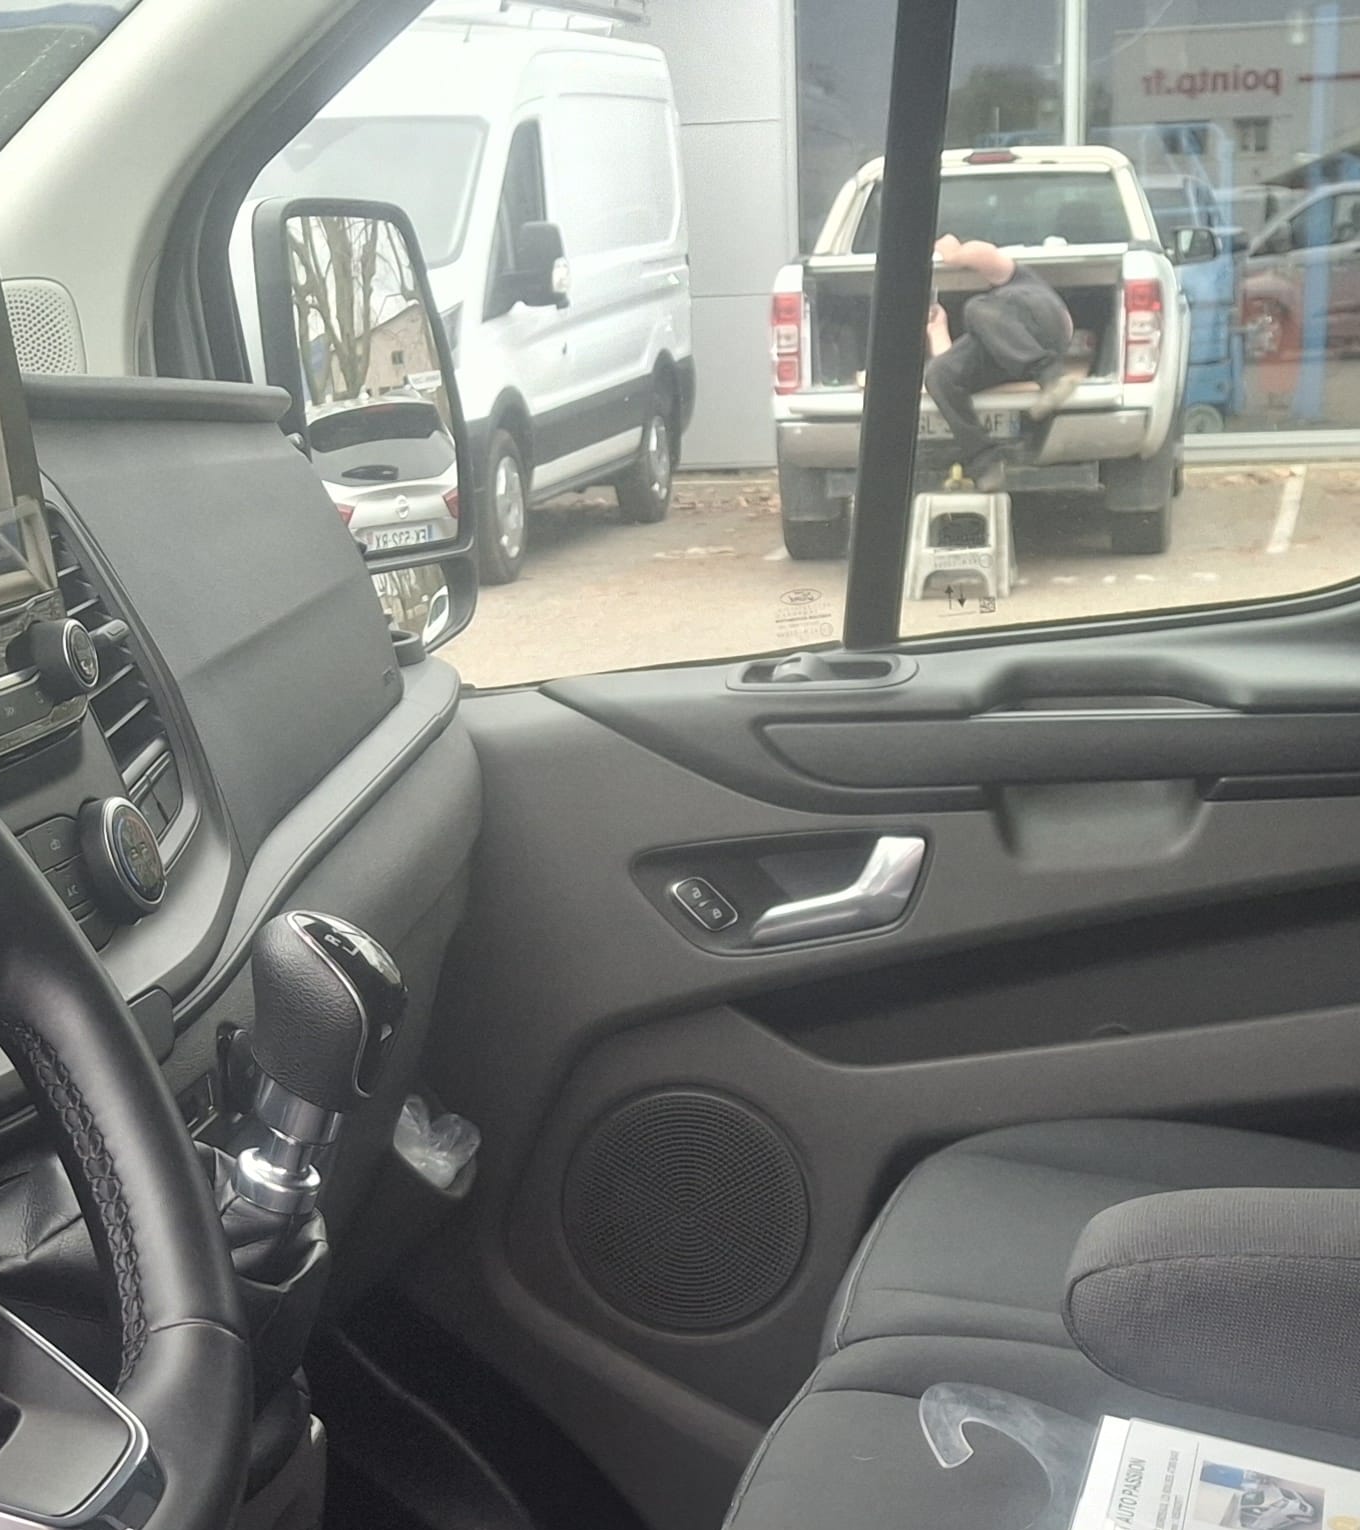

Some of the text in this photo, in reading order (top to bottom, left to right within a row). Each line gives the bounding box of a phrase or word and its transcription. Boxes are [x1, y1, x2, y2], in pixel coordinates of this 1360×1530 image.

[324, 934, 342, 947] R
[1121, 1455, 1146, 1497] PASSION
[1115, 1496, 1138, 1524] AUTO
